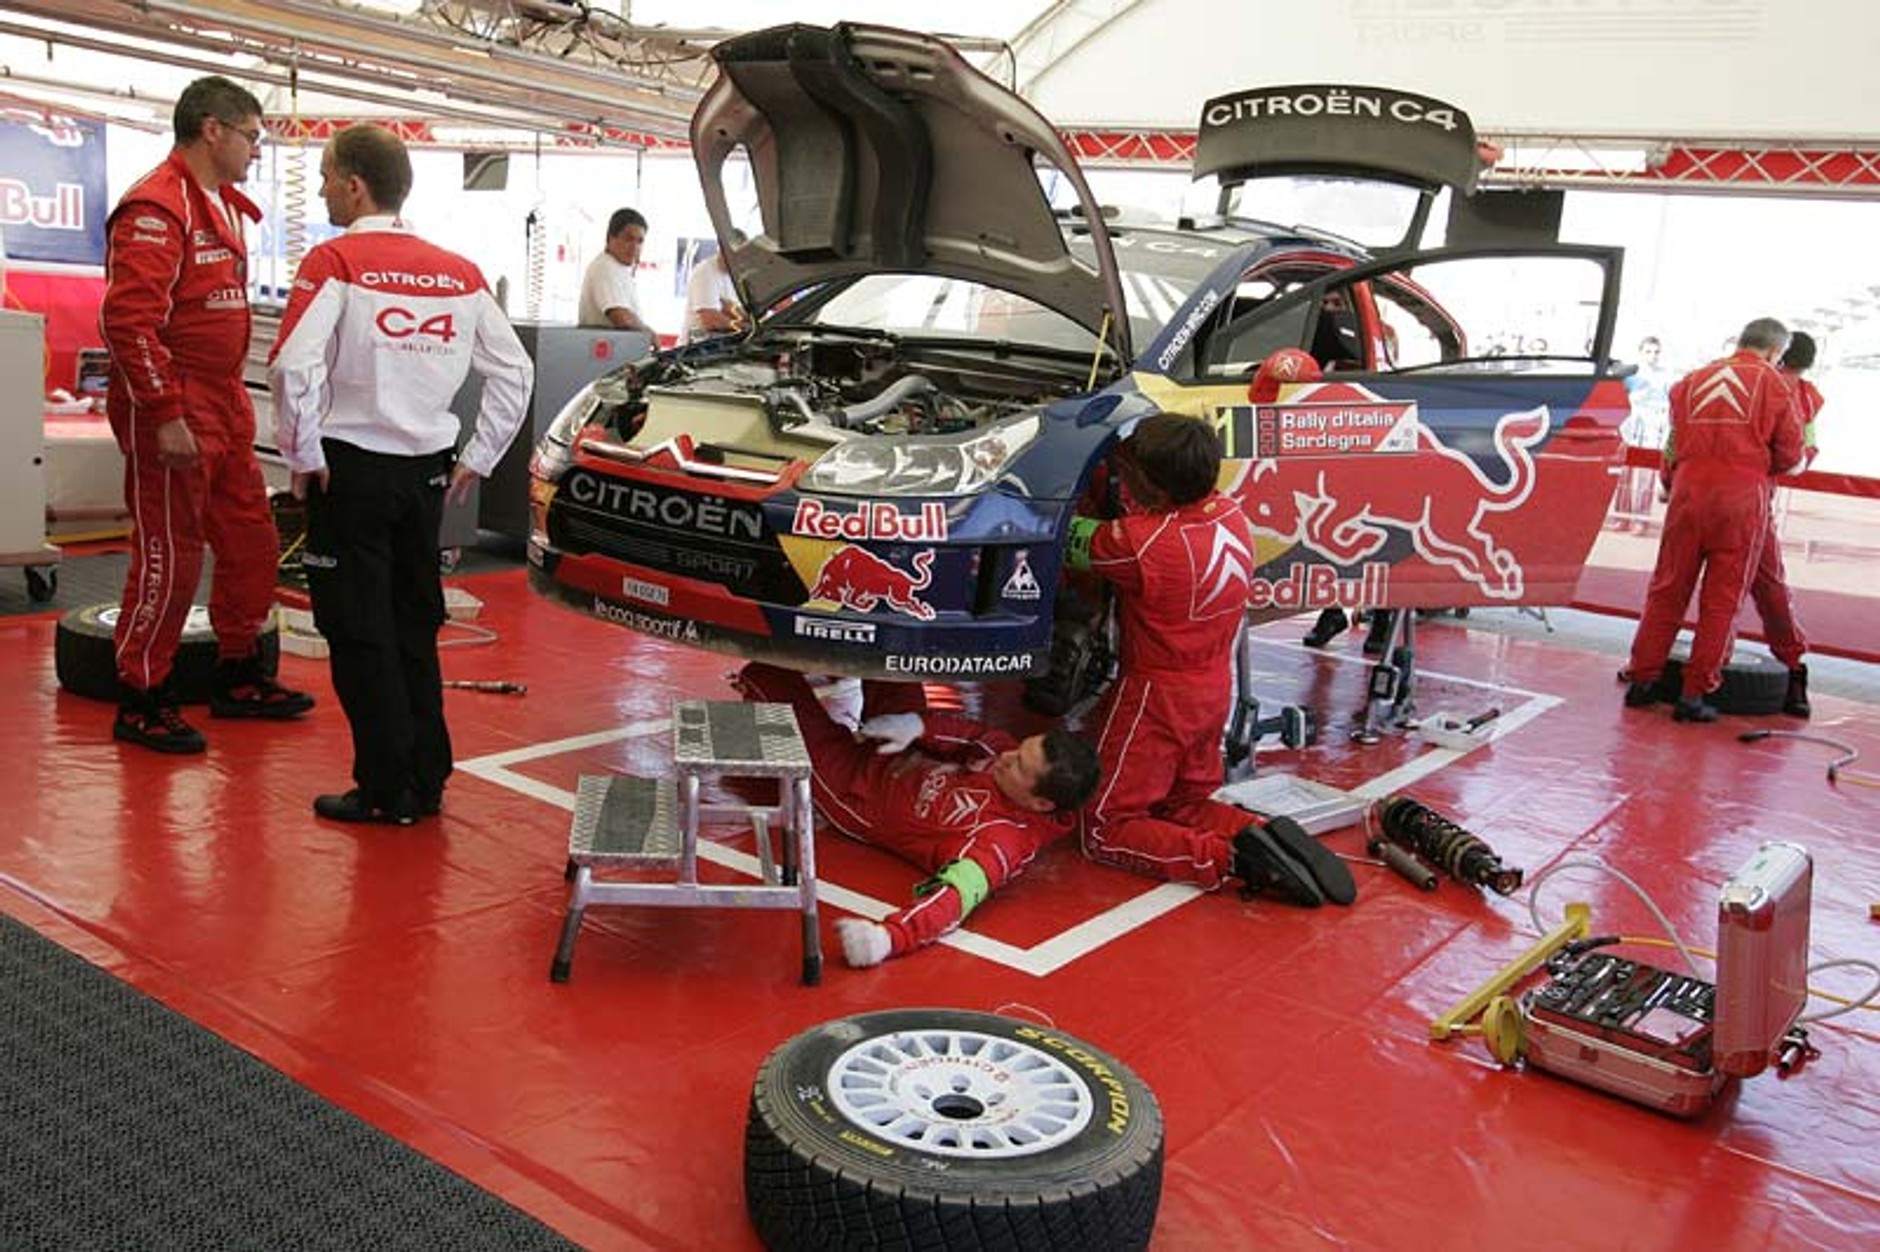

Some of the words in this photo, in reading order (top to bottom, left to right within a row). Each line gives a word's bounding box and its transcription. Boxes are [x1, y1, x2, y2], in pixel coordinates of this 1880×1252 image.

[1205, 89, 1382, 127] CITROËN
[1389, 100, 1460, 132] C4
[0, 180, 83, 229] Bull
[360, 271, 466, 291] CITROËN
[375, 306, 457, 344] C4
[1281, 411, 1327, 430] Rally
[1331, 409, 1395, 428] d'Italia
[1281, 431, 1372, 451] Sardegna
[569, 472, 763, 539] CITROËN
[793, 498, 870, 540] Red
[871, 499, 949, 542] Bull
[1246, 562, 1305, 609] ed
[1306, 562, 1391, 609] Bull
[795, 615, 877, 644] PIRELLI
[885, 654, 1034, 674] EURODATACAR
[1014, 1026, 1130, 1135] SCORPION
